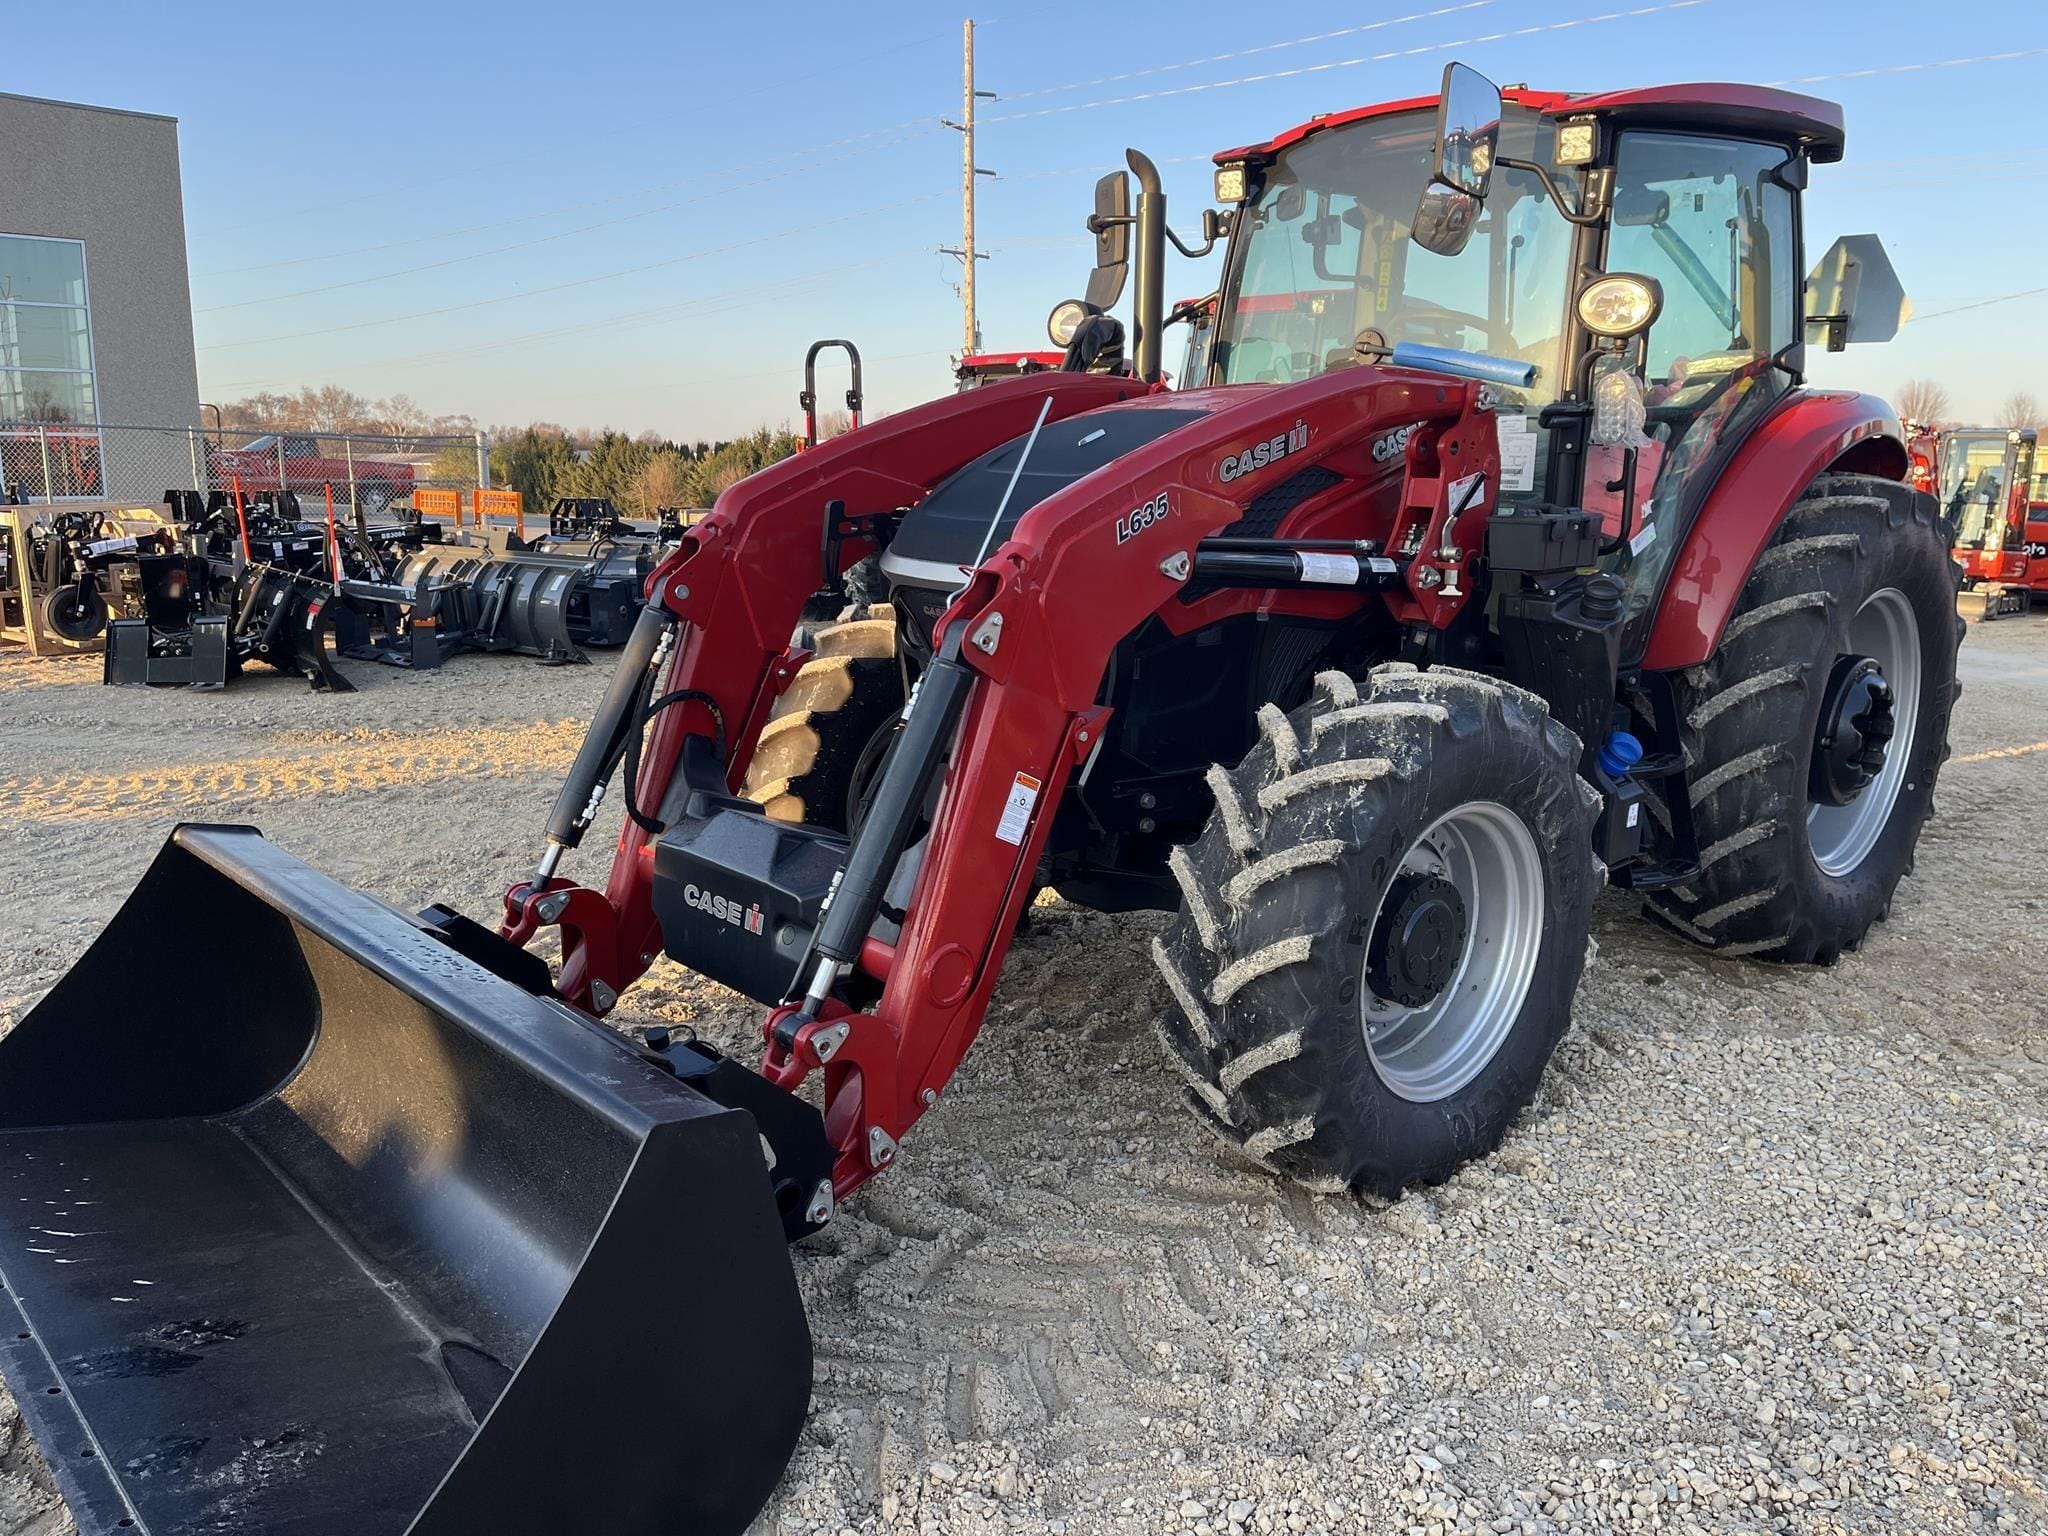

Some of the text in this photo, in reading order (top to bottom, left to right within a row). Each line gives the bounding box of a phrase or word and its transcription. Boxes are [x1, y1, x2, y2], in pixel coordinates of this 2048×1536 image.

[1218, 433, 1286, 483] CASE
[1116, 491, 1169, 545] L635
[684, 884, 743, 926] CASE
